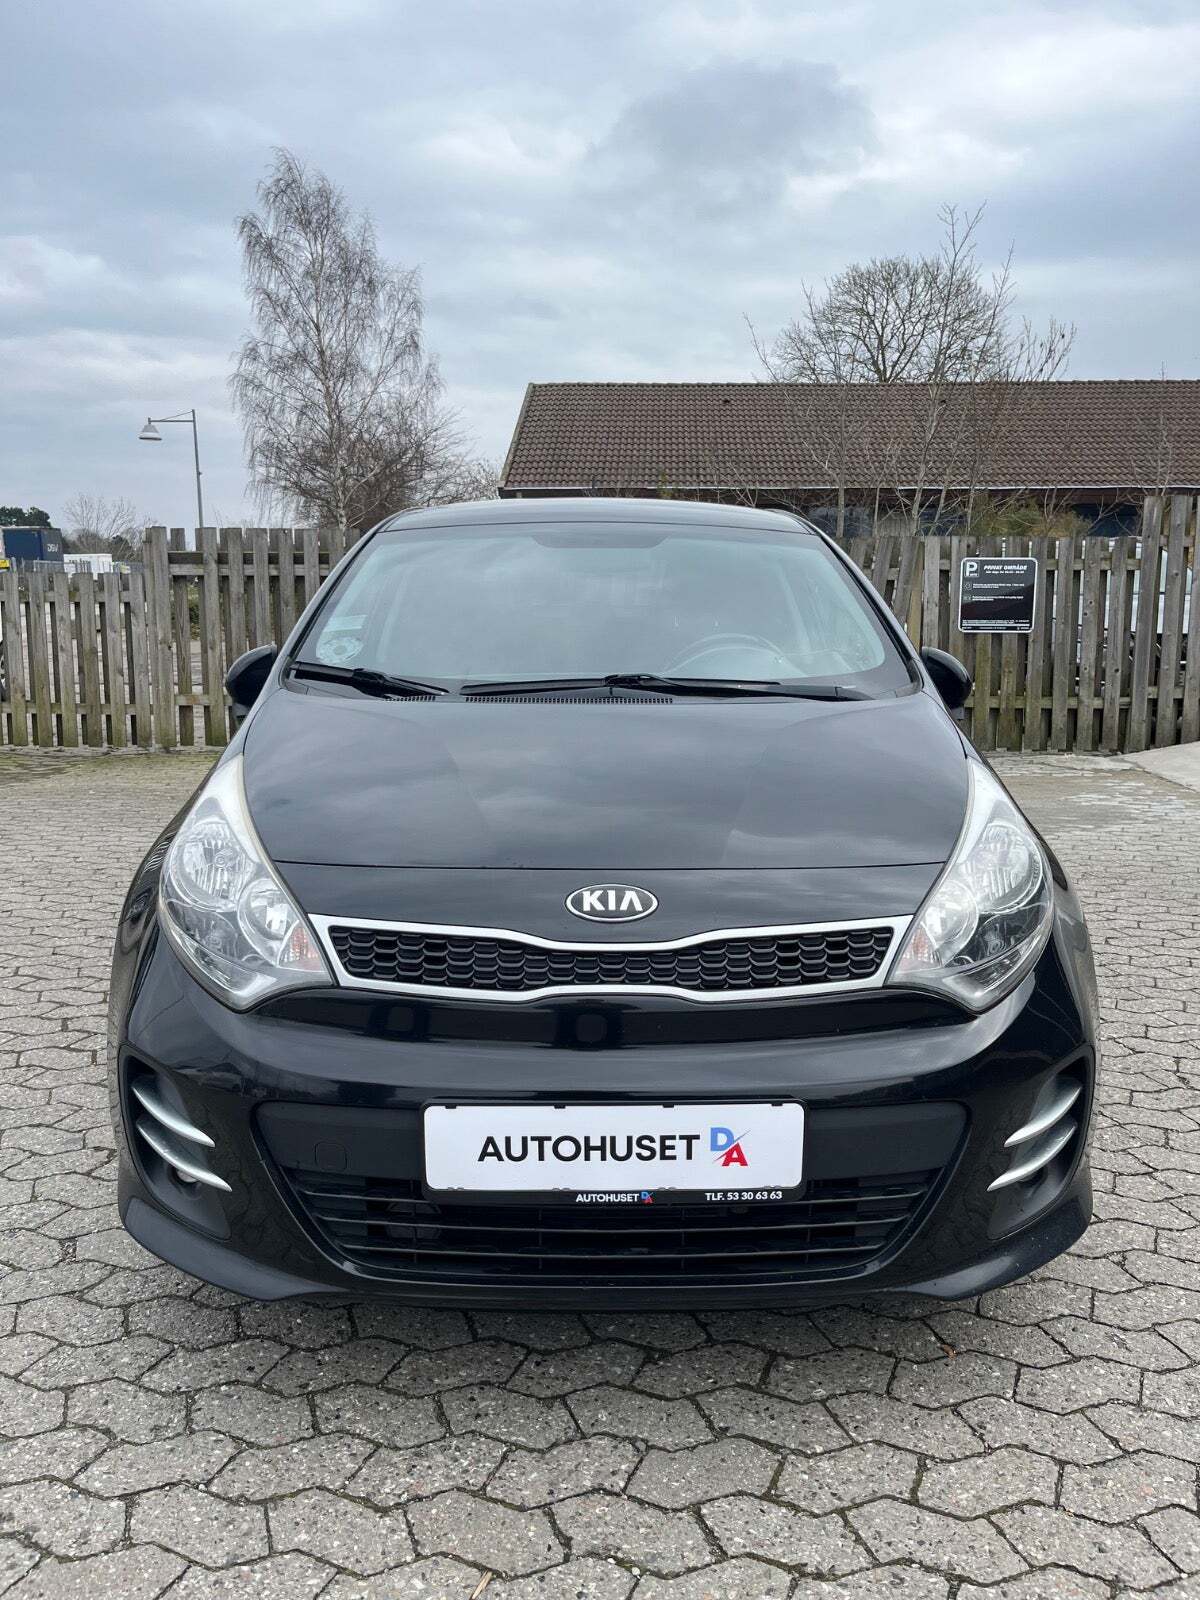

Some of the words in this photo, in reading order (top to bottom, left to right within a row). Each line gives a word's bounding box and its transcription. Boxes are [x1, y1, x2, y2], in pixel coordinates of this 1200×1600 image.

[966, 561, 978, 576] P
[582, 890, 643, 911] KIA
[478, 1134, 700, 1163] AUTOHUSET
[576, 1193, 639, 1202] AUTOHUSET
[705, 1192, 724, 1201] TLF.
[727, 1192, 739, 1201] 53
[741, 1191, 753, 1200] 30
[755, 1191, 768, 1200] 63
[770, 1191, 782, 1200] 63
